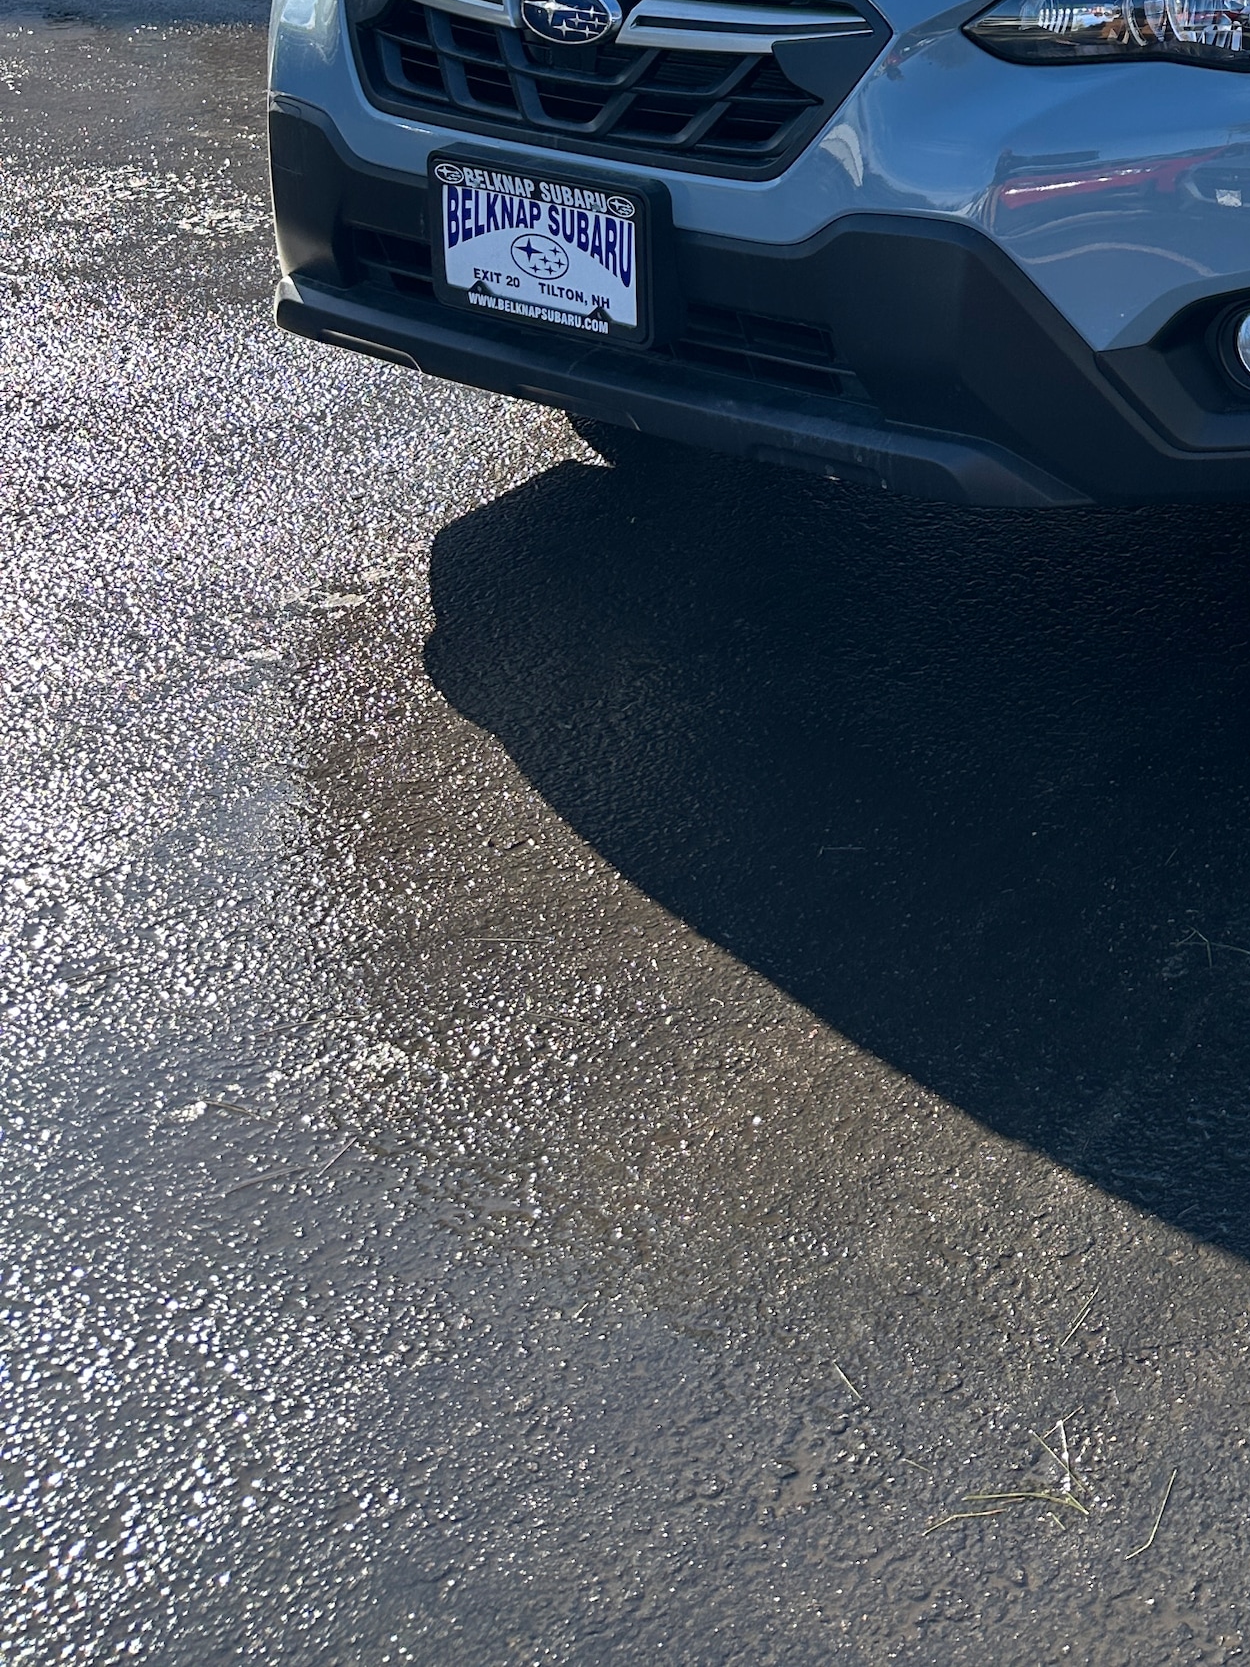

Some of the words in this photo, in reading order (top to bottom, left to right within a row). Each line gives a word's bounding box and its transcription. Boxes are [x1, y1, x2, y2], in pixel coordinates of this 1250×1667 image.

[463, 167, 535, 198] BELKNAP
[540, 181, 607, 213] SUBARU
[447, 185, 541, 249] BELKNAP
[548, 205, 632, 288] SUBARU
[473, 267, 502, 284] EXIT
[506, 275, 520, 288] 20
[538, 282, 588, 306] TILTON,
[592, 294, 610, 309] NH
[468, 291, 609, 334] WWW.BELKNAPSUBARU.COM
